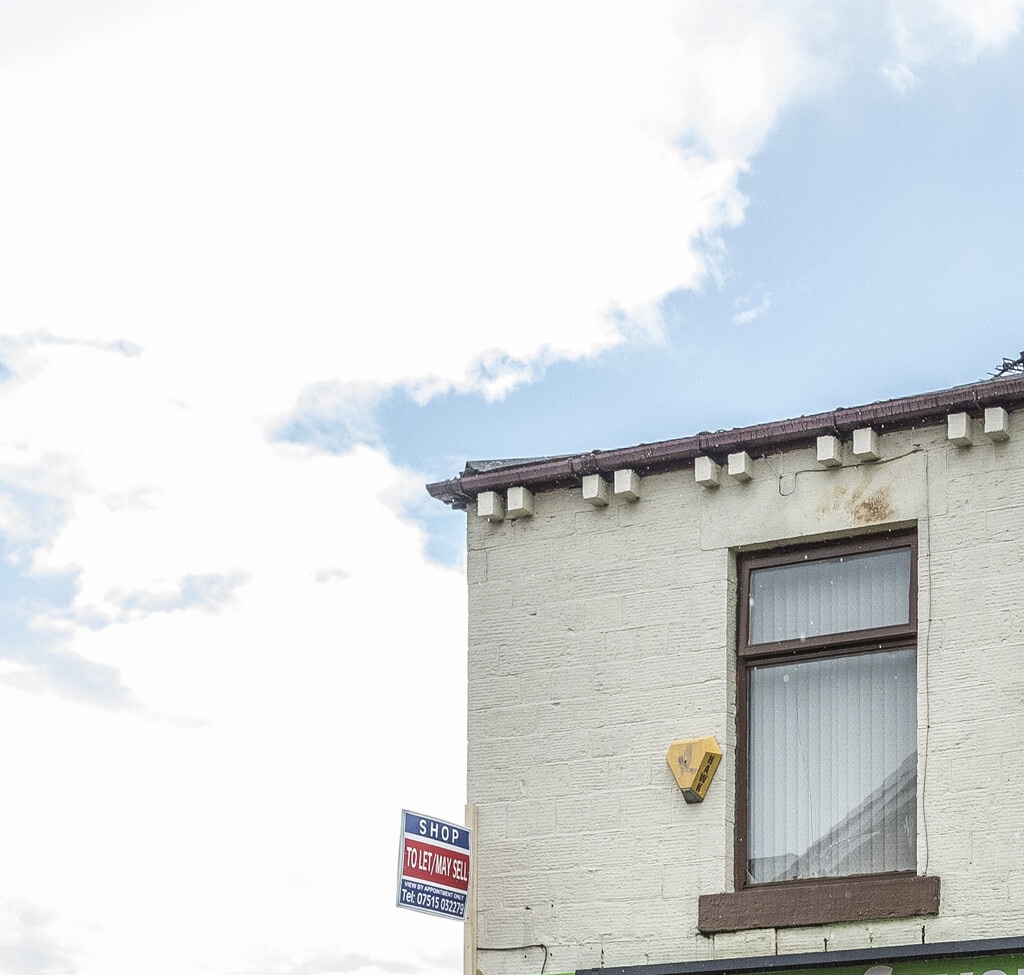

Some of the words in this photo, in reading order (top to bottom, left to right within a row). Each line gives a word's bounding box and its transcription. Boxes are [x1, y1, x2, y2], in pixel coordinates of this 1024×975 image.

[419, 820, 459, 843] SHOP
[407, 847, 417, 868] TO
[419, 850, 452, 877] LET/MAY
[453, 859, 467, 881] SELL
[402, 889, 415, 903] Tel:
[417, 893, 439, 908] 07515
[440, 898, 464, 914] 032279
[424, 885, 453, 898] APPOINTMENT
